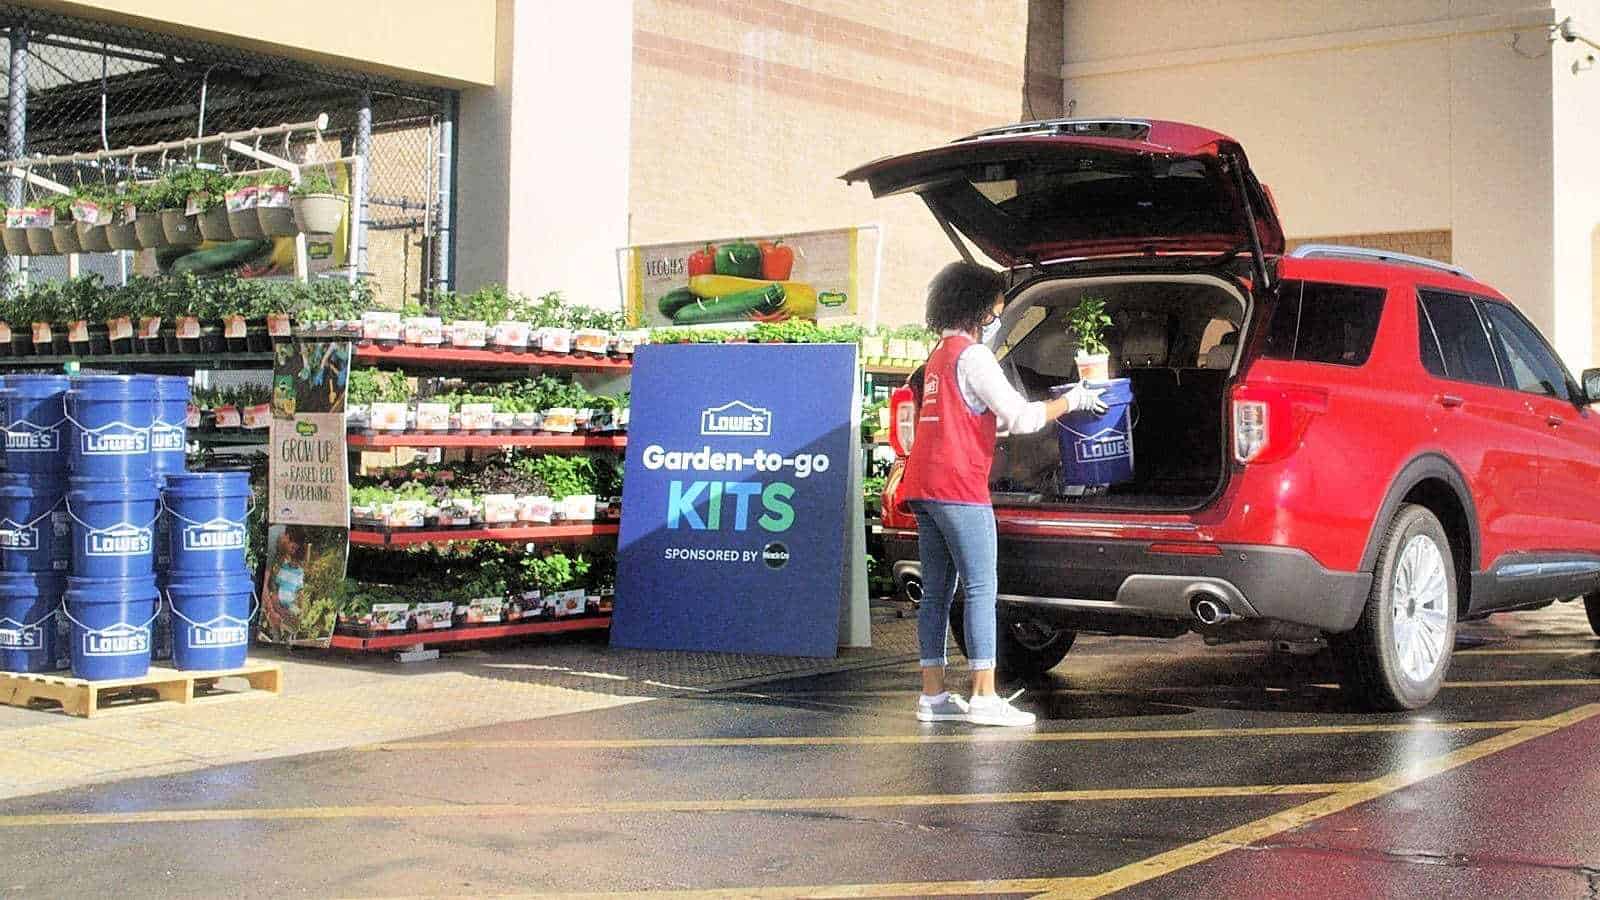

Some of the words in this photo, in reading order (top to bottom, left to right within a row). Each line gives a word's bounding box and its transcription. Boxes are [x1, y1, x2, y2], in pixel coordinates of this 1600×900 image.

[709, 414, 765, 431] LOWE'S
[282, 439, 314, 462] GROW
[318, 439, 333, 463] UP
[642, 445, 830, 478] Garden-to-go
[667, 480, 796, 532] KITS
[92, 533, 149, 552] LOWE'S
[664, 548, 740, 561] SPONSORED
[742, 550, 758, 562] BY
[90, 633, 146, 652] LOWE'S
